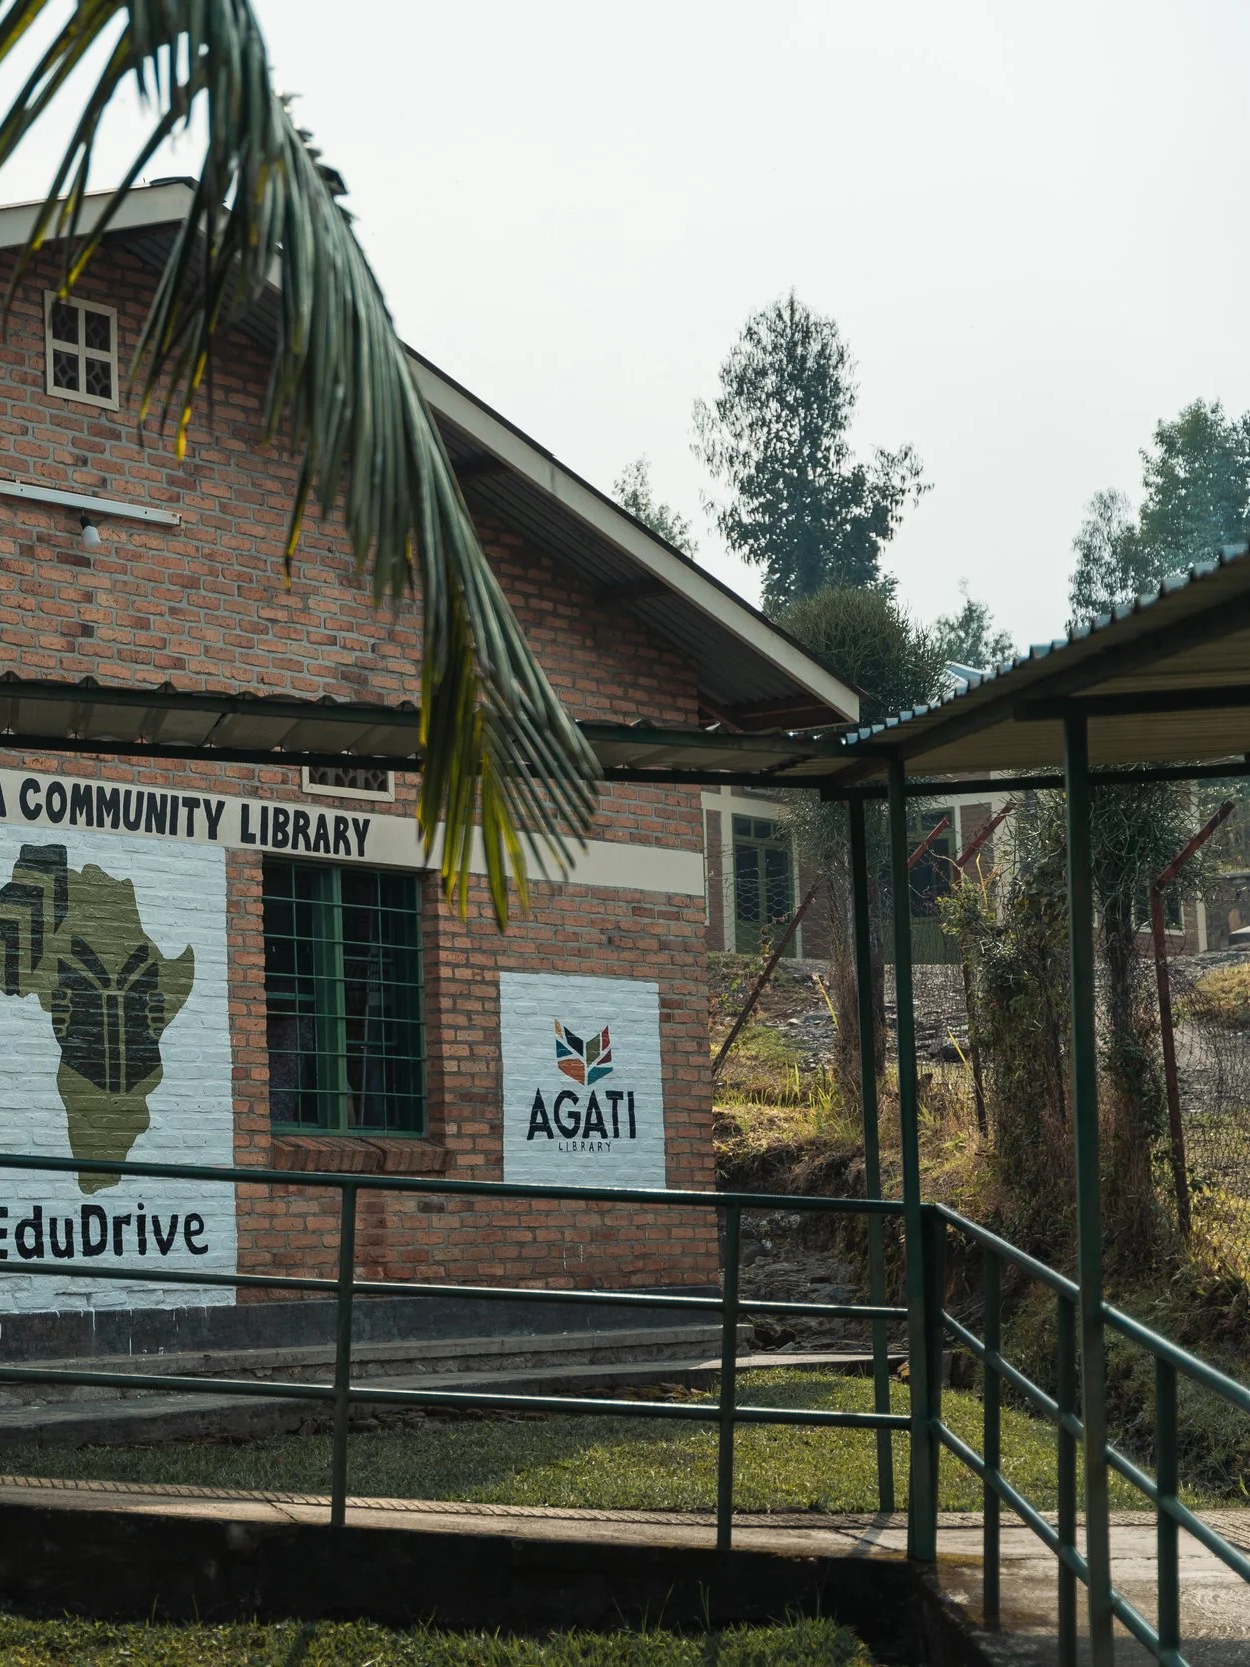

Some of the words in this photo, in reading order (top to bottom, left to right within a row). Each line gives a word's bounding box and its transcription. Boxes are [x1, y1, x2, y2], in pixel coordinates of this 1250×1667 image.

[19, 777, 226, 840] COMMUNITY
[240, 803, 371, 857] LIBRARY
[526, 1087, 637, 1141] AGATI
[558, 1141, 612, 1152] LIBRARY
